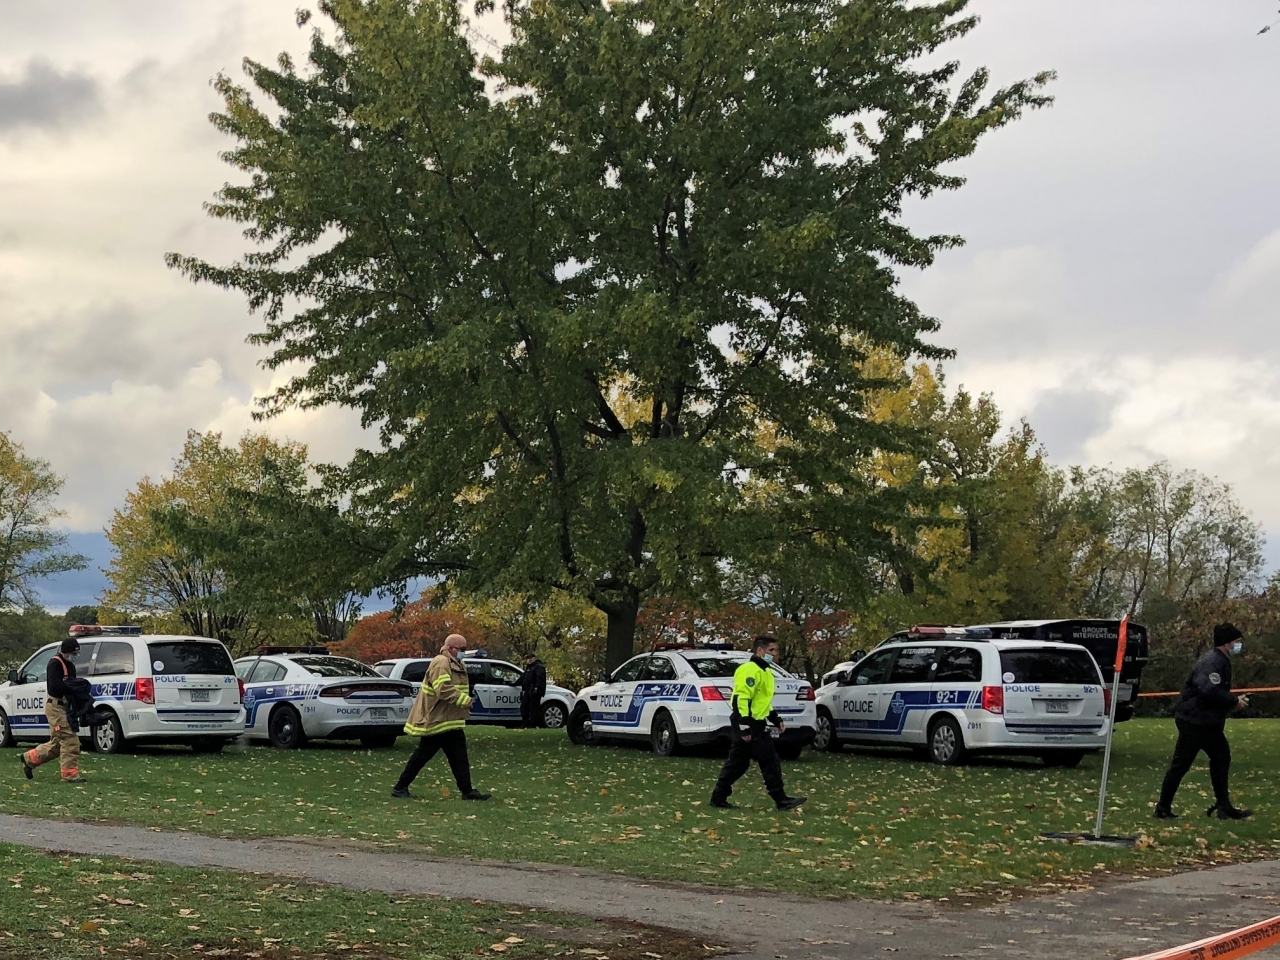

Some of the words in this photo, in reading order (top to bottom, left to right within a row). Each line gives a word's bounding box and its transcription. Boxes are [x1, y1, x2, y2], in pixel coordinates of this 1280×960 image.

[102, 683, 121, 695] 26-1
[285, 684, 307, 695] 13-11
[662, 684, 680, 695] 21-2
[496, 696, 522, 704] POLIC
[600, 695, 623, 707] POLICE
[936, 690, 959, 703] 92-1
[17, 698, 43, 709] POLICE
[843, 700, 873, 713] POLICE
